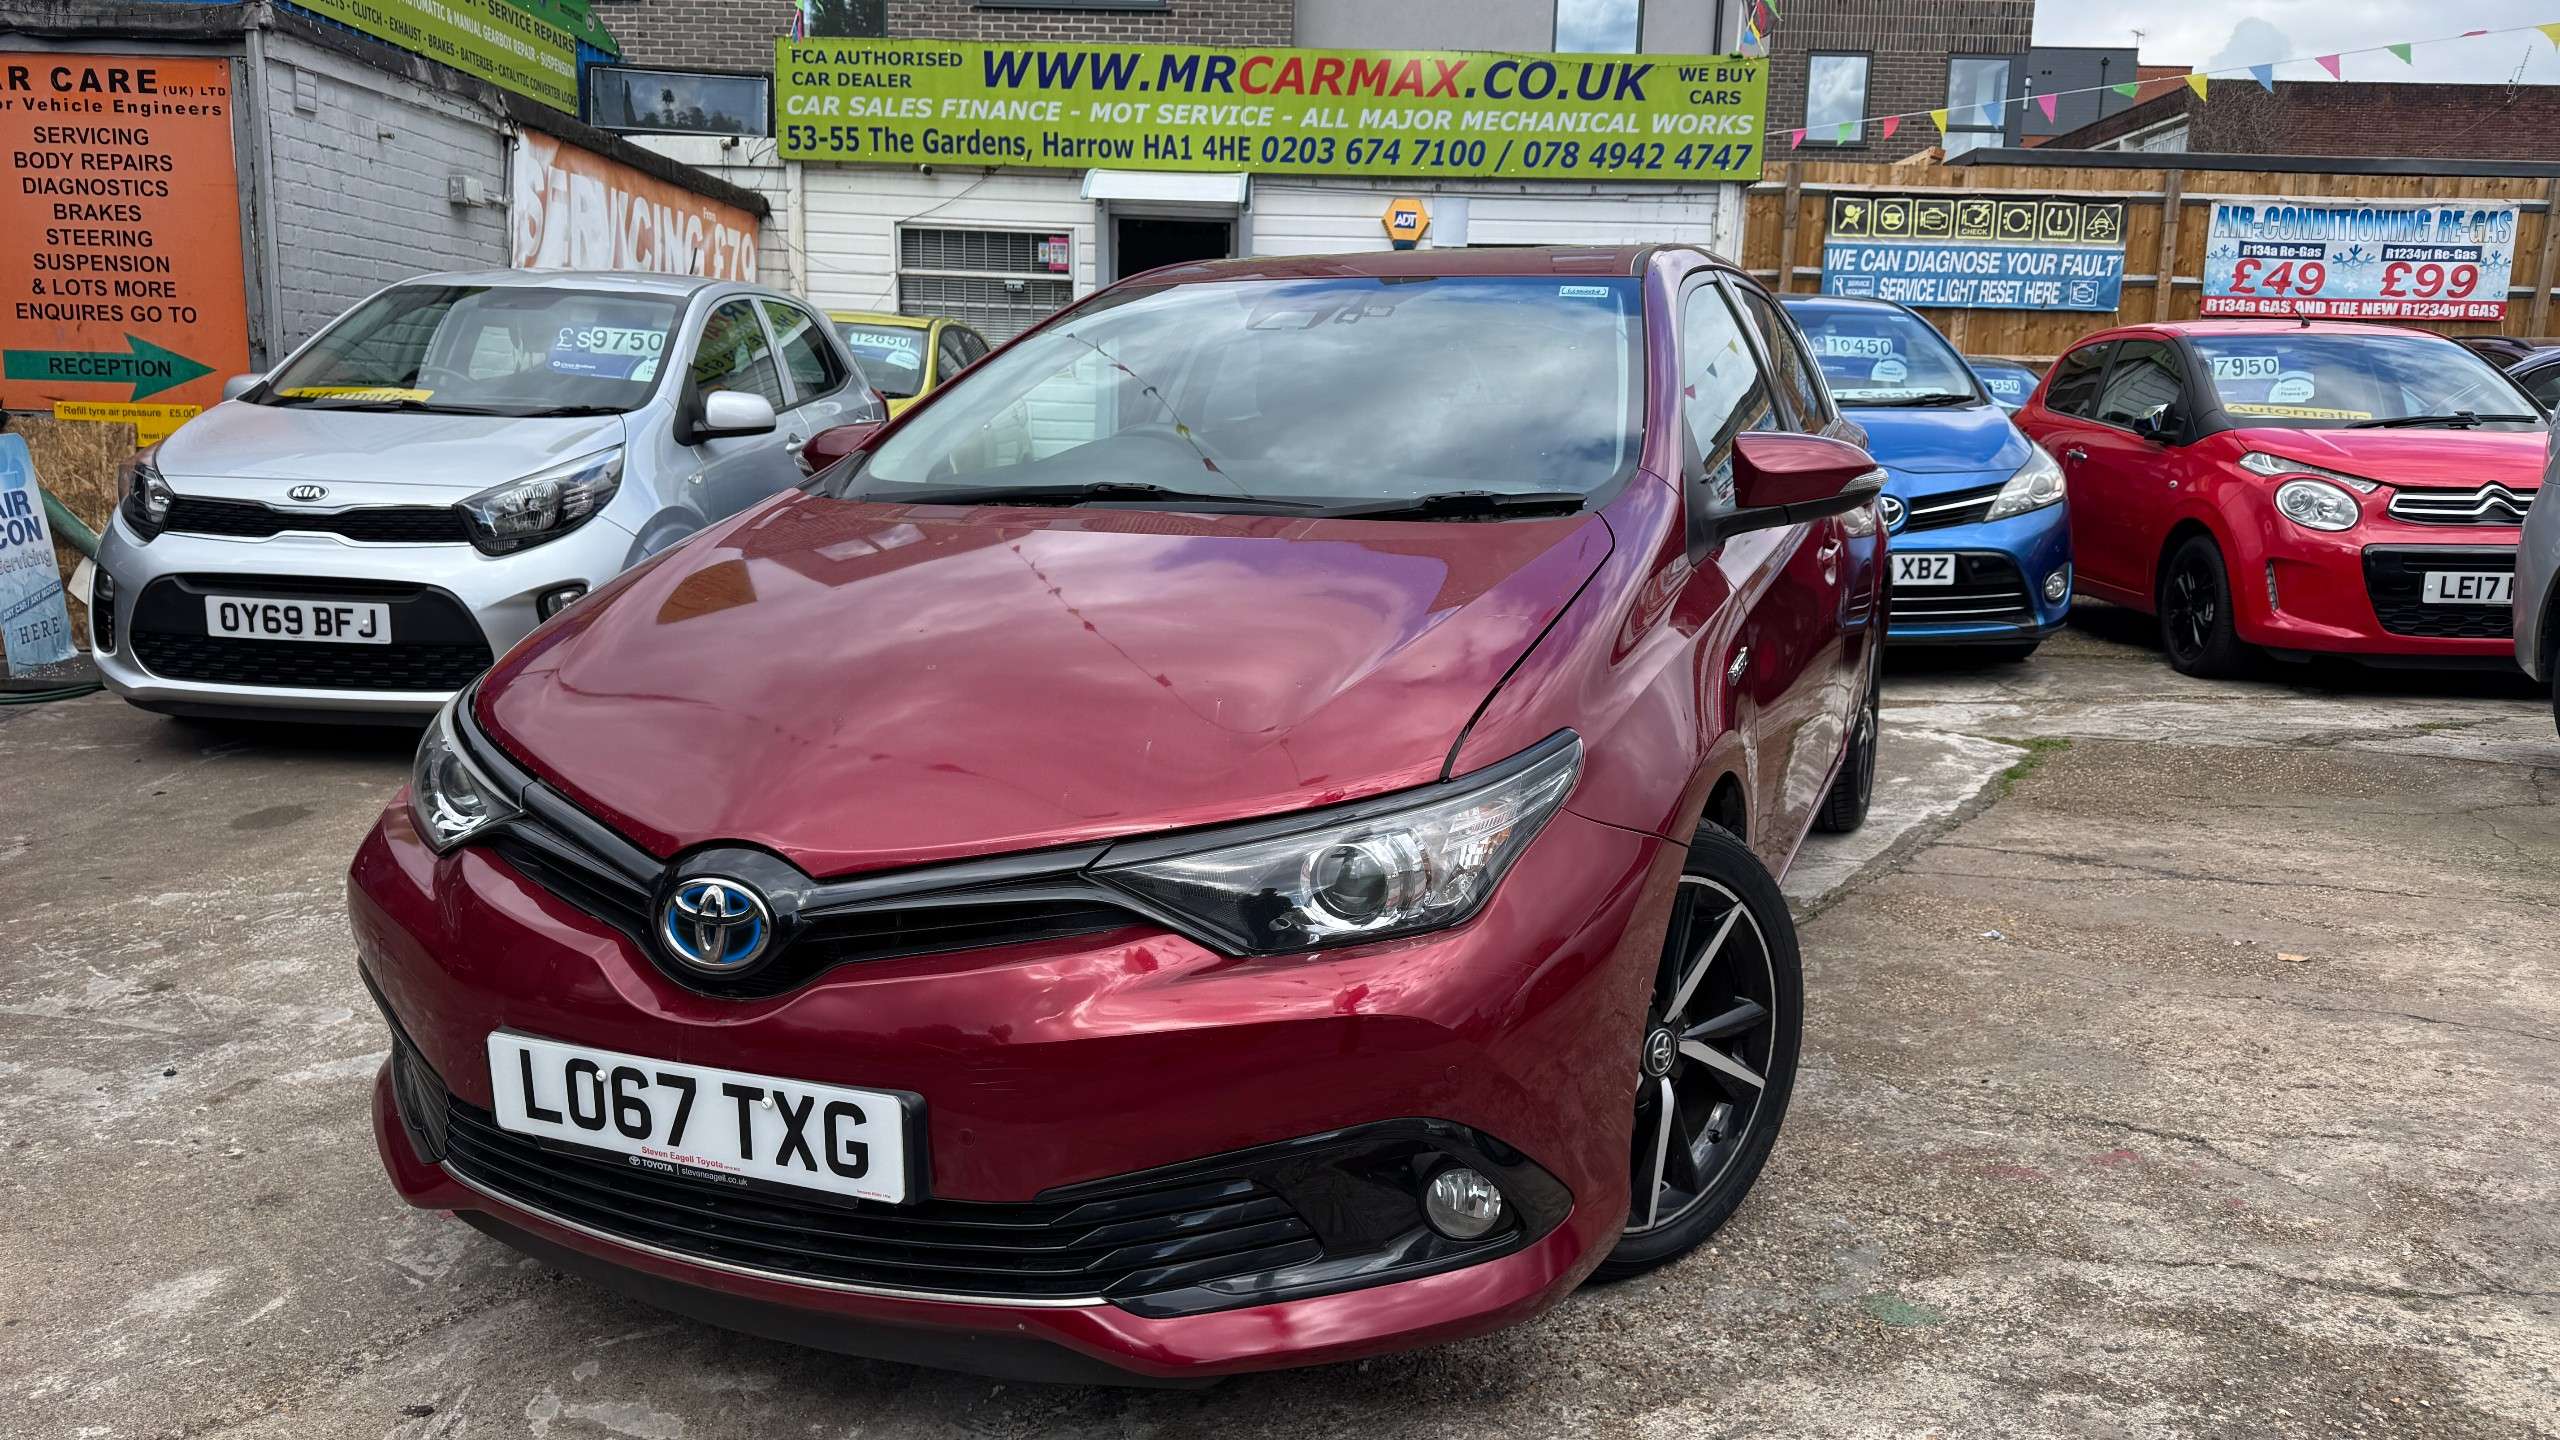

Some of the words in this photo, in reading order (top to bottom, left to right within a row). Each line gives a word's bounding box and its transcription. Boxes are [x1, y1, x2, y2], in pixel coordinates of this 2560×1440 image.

[398, 0, 445, 21] TOMATIC
[453, 11, 482, 38] MANUAL
[482, 24, 512, 49] GEARBOX
[513, 40, 536, 62] REPAIR
[489, 0, 531, 34] SERVICE
[535, 22, 576, 54] REPAIRS
[352, 2, 383, 26] CLUTCH
[389, 16, 421, 43] EXHAUST
[428, 34, 455, 57] BRAKES
[460, 47, 494, 73] BATTERIES
[499, 63, 530, 88] CATALYTIC
[530, 78, 561, 99] CONVERTER
[791, 48, 828, 65] FCA
[834, 50, 964, 68] AUTHORISED
[50, 65, 158, 94] CARE
[163, 85, 195, 98] (UK)
[200, 86, 227, 97] LTD
[791, 71, 835, 87] CAR
[838, 72, 912, 89] DEALER
[982, 48, 1655, 102] WWW.MRCARMAX.CO.UK
[1679, 67, 1711, 83] WE
[1716, 67, 1757, 84] BUY
[22, 97, 103, 113] Vehicle
[113, 99, 222, 117] Engineers
[1689, 89, 1742, 105] CARS
[786, 95, 840, 117] CAR
[849, 96, 933, 119] SALES
[940, 98, 1062, 122] FINANCE
[1089, 102, 1147, 125] MOT
[1156, 104, 1273, 127] SERVICE
[1301, 107, 1349, 130] ALL
[1360, 109, 1451, 132] MAJOR
[1461, 110, 1640, 135] MECHANICAL
[1651, 113, 1754, 136] WORKS
[33, 126, 149, 146] SERVICING
[786, 124, 861, 153] 53-55
[868, 126, 914, 153] The
[922, 128, 1032, 162] Gardens,
[1042, 131, 1134, 159] Harrow
[1143, 133, 1193, 161] HA1
[1202, 135, 1251, 162] 4HE
[1261, 136, 1335, 165] 0203
[1345, 138, 1401, 166] 674
[1412, 139, 1487, 168] 7100
[1522, 141, 1579, 169] 078
[1589, 142, 1664, 170] 4942
[1674, 143, 1753, 172] 4747
[14, 151, 74, 170] BODY
[80, 153, 173, 172] REPAIRS
[22, 177, 169, 198] DIAGNOSTICS
[53, 203, 142, 222] BRAKES
[1394, 212, 1417, 227] ADT
[1961, 228, 1988, 236] CHECK
[2213, 204, 2431, 244] AIR-CONDITIONING
[2436, 208, 2513, 245] RE-GAS
[46, 228, 153, 248] STEERING
[713, 222, 756, 284] £79
[2242, 245, 2278, 257] R134a
[2280, 246, 2322, 258] Re-Gas
[2385, 248, 2431, 261] R1234yf
[2433, 249, 2478, 261] Re-Gas
[33, 253, 170, 273] SUSPENSION
[1827, 248, 1858, 271] WE
[1860, 249, 1902, 272] CAN
[1904, 250, 2002, 274] DIAGNOSE
[2007, 252, 2057, 276] YOUR
[2060, 254, 2121, 277] FAULT
[2228, 258, 2326, 296] £49
[2380, 261, 2479, 298] £99
[32, 278, 46, 295] &
[52, 278, 107, 297] LOTS
[114, 279, 177, 298] MORE
[1878, 277, 1937, 300] SERVICE
[1937, 278, 1979, 303] LIGHT
[1978, 279, 2024, 303] RESET
[2024, 281, 2062, 304] HERE
[15, 302, 124, 322] ENQUIRES
[130, 305, 163, 323] GO
[168, 306, 198, 324] TO
[2206, 299, 2256, 313] R134a
[2259, 299, 2291, 314] GAS
[2295, 300, 2326, 315] AND
[2329, 301, 2359, 315] THE
[2361, 302, 2398, 316] NEW
[2400, 302, 2465, 318] R1234yf
[2468, 304, 2500, 318] GAS
[50, 357, 172, 378] RECEPTION
[2215, 357, 2277, 376] 7950
[63, 406, 87, 416] Refill
[88, 407, 106, 419] tyre
[108, 408, 120, 417] air
[122, 408, 162, 419] pressure
[2228, 404, 2368, 419] Automatic
[293, 486, 321, 499] KIA
[1900, 557, 1949, 580] XBZ
[2439, 575, 2500, 600] LE17
[219, 602, 303, 635] OY69
[312, 606, 377, 638] BFJ
[19, 617, 60, 645] HERE
[519, 1048, 697, 1147] LO67
[722, 1082, 869, 1179] TXG
[641, 1146, 668, 1158] Steven
[670, 1152, 695, 1163] Eagell
[696, 1156, 724, 1169] Toyota
[642, 1159, 674, 1173] TOYOTA
